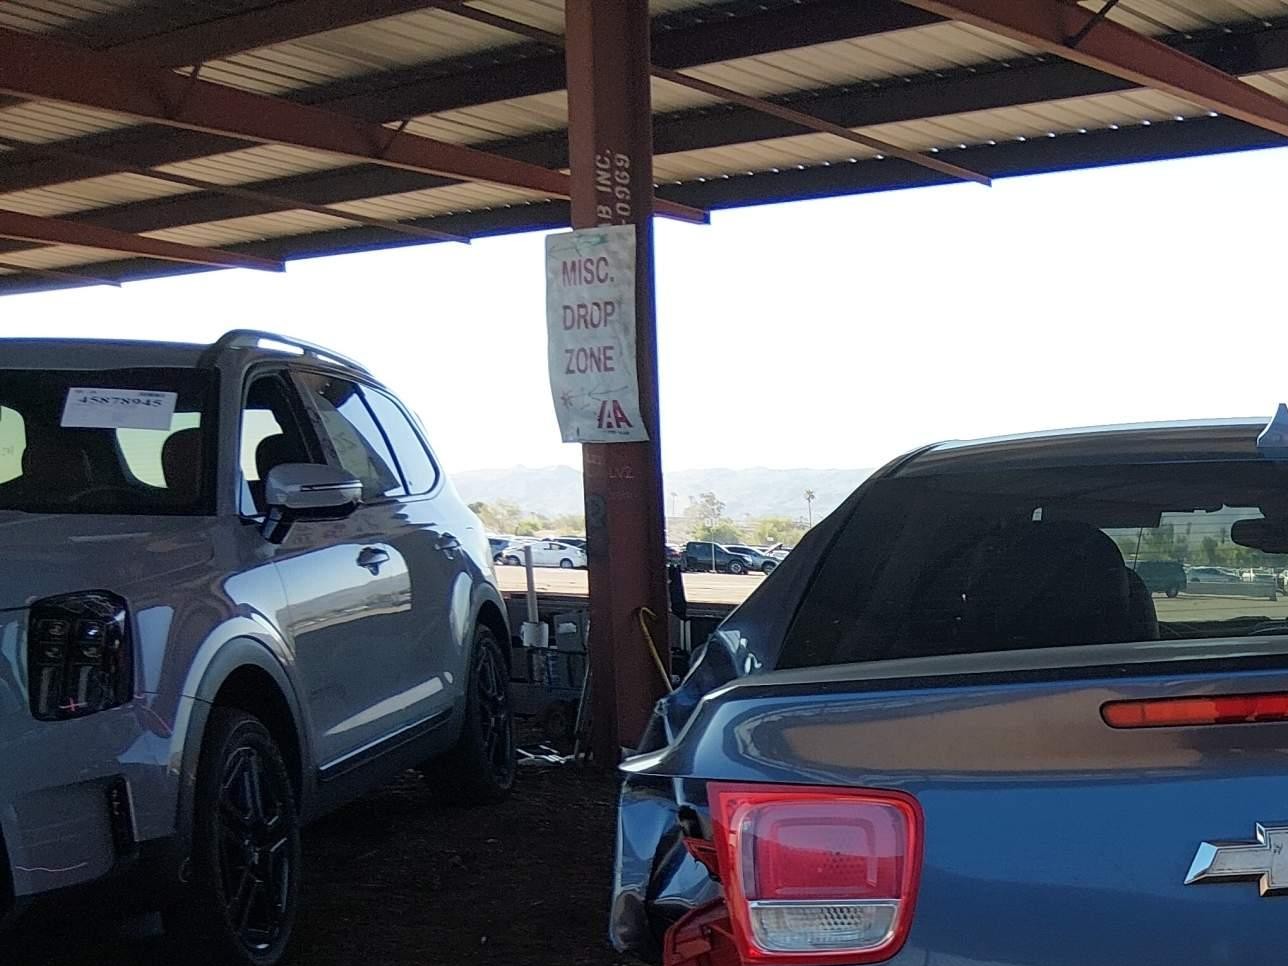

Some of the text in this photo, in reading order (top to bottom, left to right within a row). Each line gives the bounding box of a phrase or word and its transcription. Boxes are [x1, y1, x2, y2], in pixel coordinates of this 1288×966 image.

[595, 148, 613, 193] INC.
[561, 256, 615, 285] MISC.
[562, 303, 617, 331] DROP
[564, 346, 616, 375] ZONE
